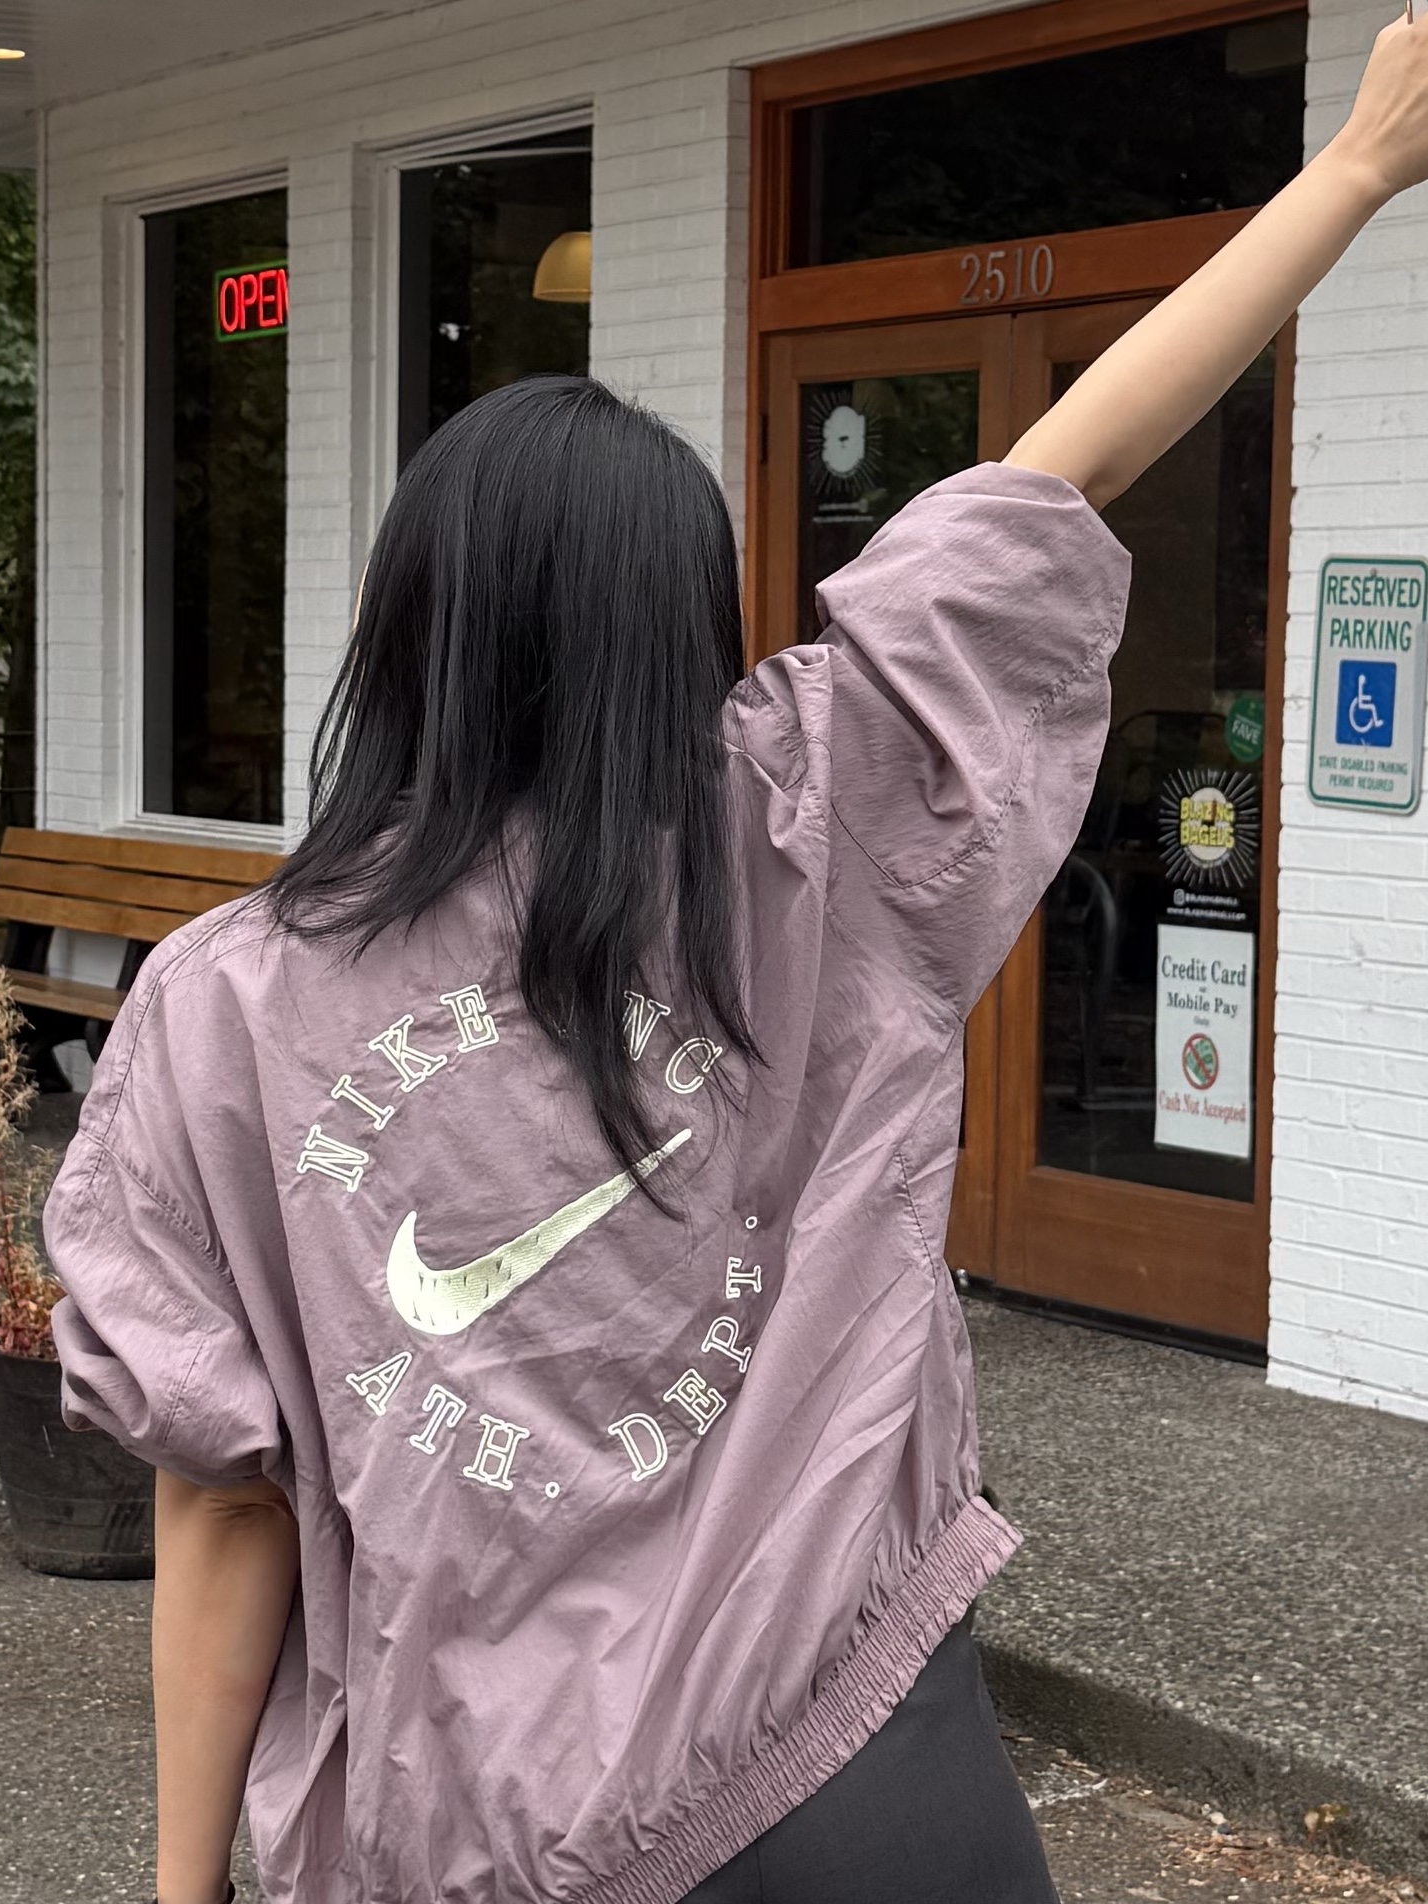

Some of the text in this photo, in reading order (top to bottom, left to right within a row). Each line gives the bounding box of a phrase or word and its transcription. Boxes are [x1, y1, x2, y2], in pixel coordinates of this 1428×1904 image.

[960, 244, 1055, 306] 2510
[1326, 575, 1422, 609] RESERVED
[1329, 617, 1412, 652] PARKING
[1232, 719, 1261, 745] FAVE
[1179, 821, 1235, 849] BAGELS
[1161, 955, 1247, 987] Credit Card
[1166, 991, 1239, 1019] Mobile Pay
[297, 983, 723, 1193] NIKE NC
[1159, 1089, 1246, 1125] Cash Not Accepted
[345, 1214, 764, 1500] ATH. DEPT.
